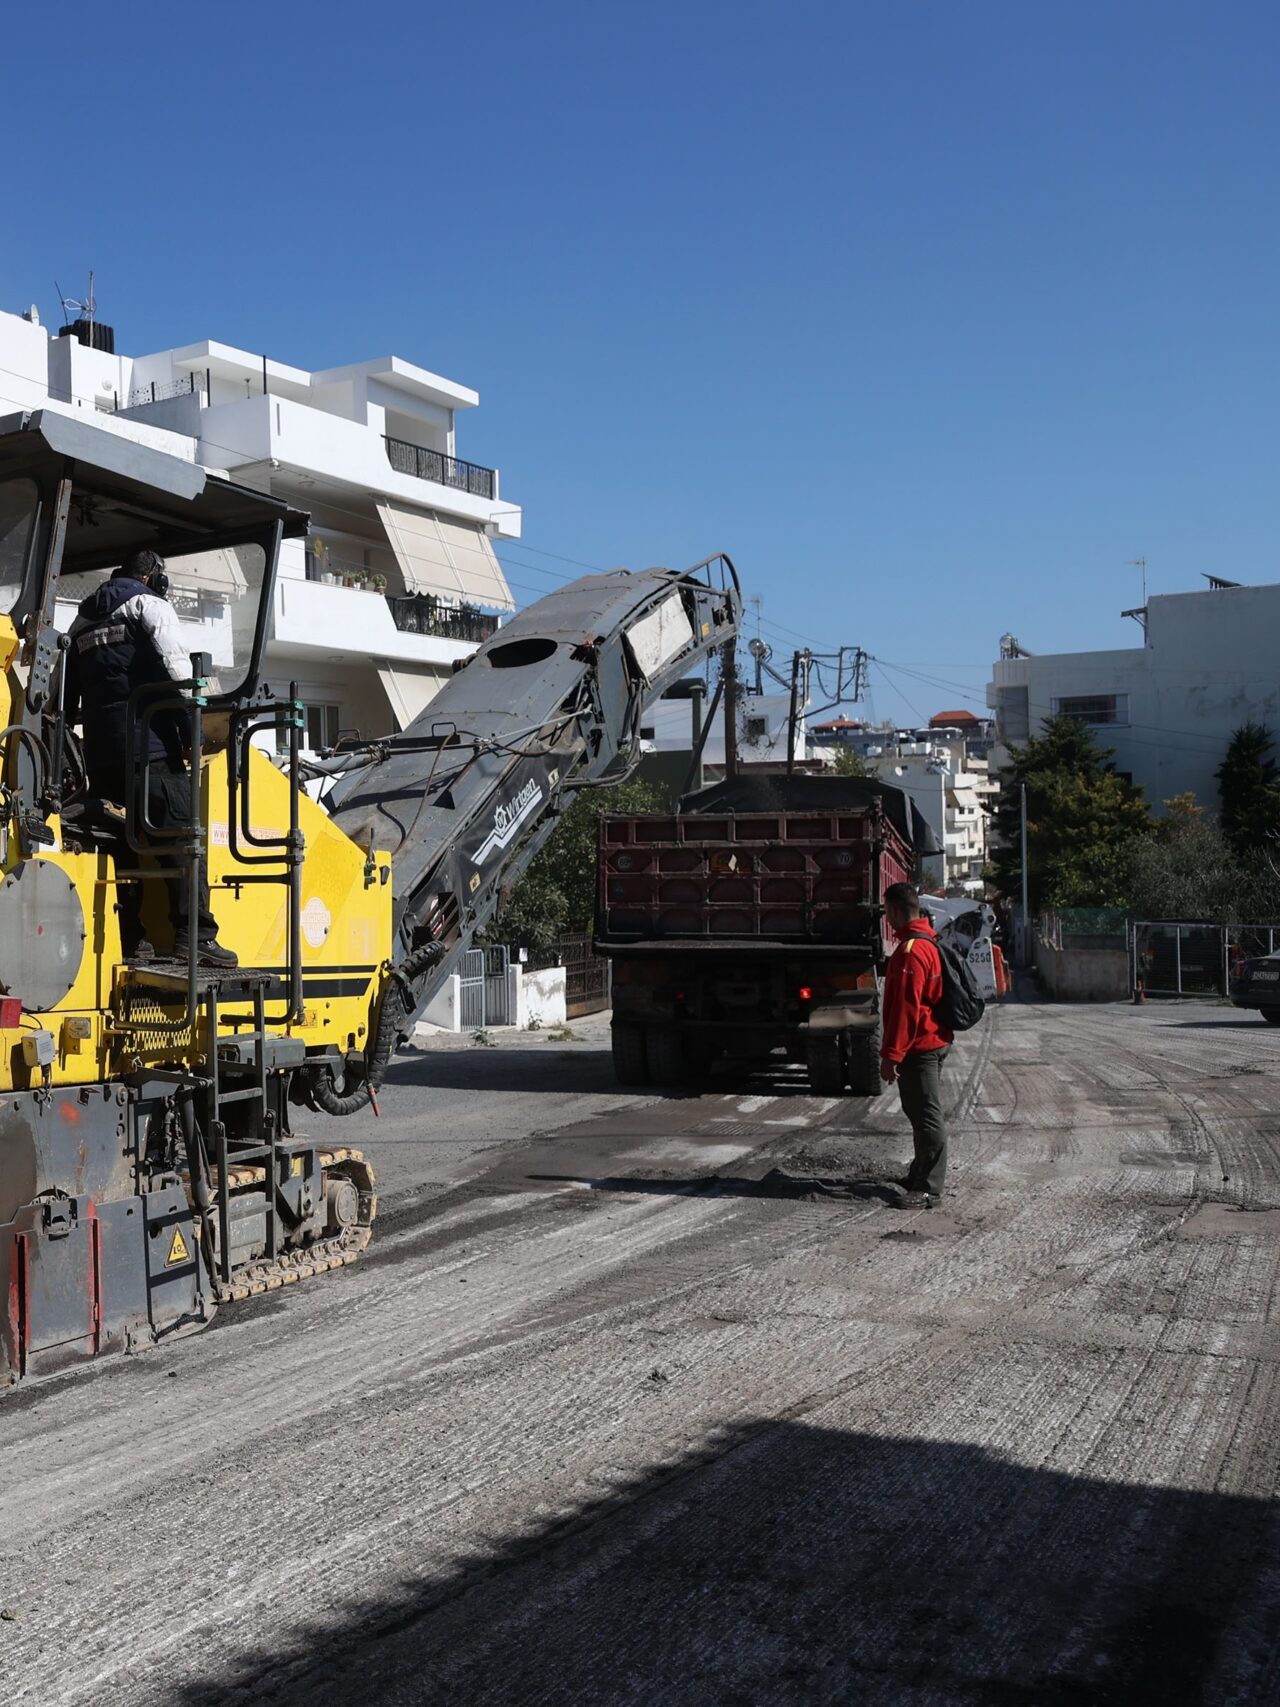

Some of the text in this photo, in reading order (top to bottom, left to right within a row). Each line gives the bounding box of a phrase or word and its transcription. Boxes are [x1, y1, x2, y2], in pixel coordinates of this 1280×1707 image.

[506, 778, 536, 820] Wirtgen
[840, 854, 850, 863] 70
[969, 952, 991, 963] S250
